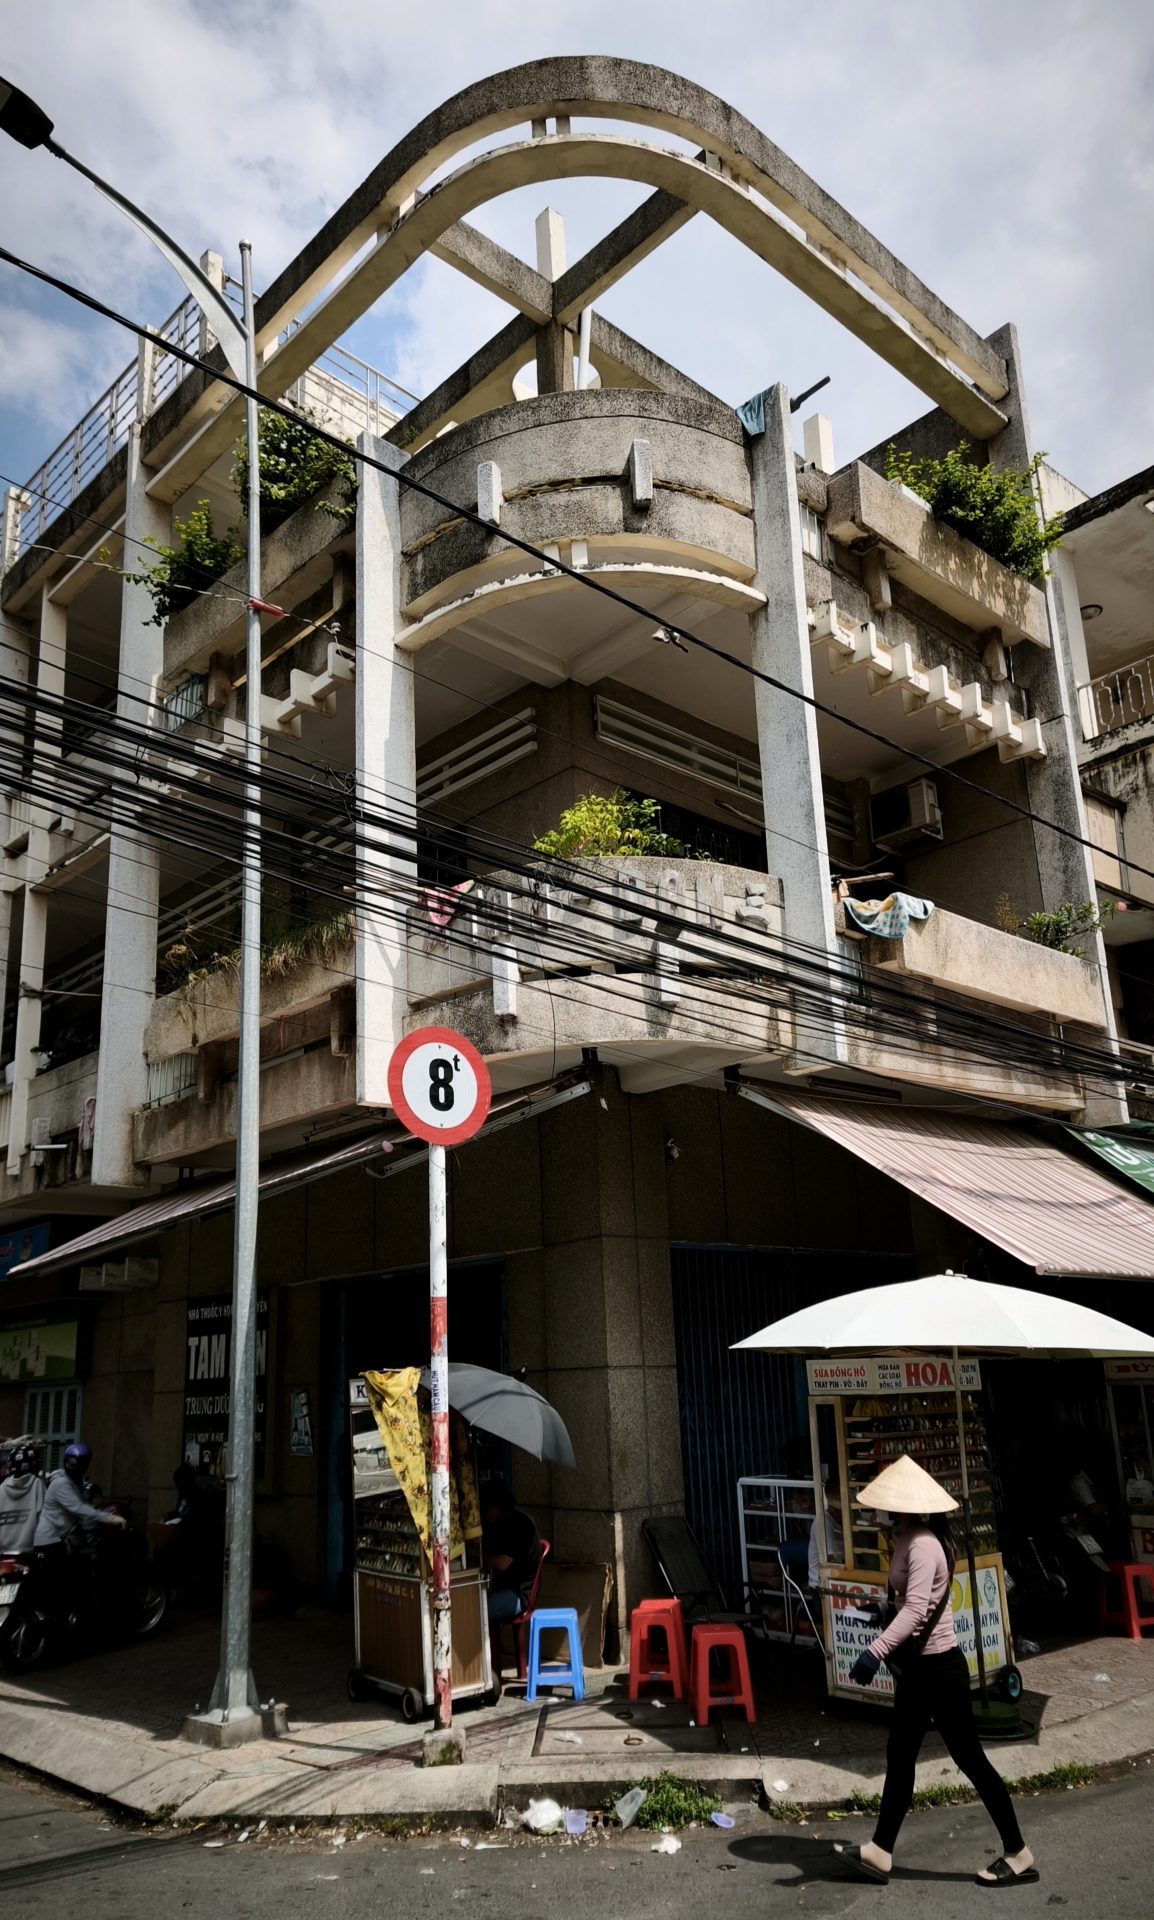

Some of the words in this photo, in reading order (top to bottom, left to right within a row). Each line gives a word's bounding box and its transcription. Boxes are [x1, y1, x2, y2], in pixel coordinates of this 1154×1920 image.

[223, 1304, 232, 1319] HỌ
[188, 1334, 227, 1380] TAM
[905, 1363, 954, 1387] HOA
[185, 1396, 213, 1415] TRUNG
[988, 1611, 1000, 1626] PIN
[982, 1633, 999, 1649] LOẠI
[836, 1646, 853, 1657] THAY
